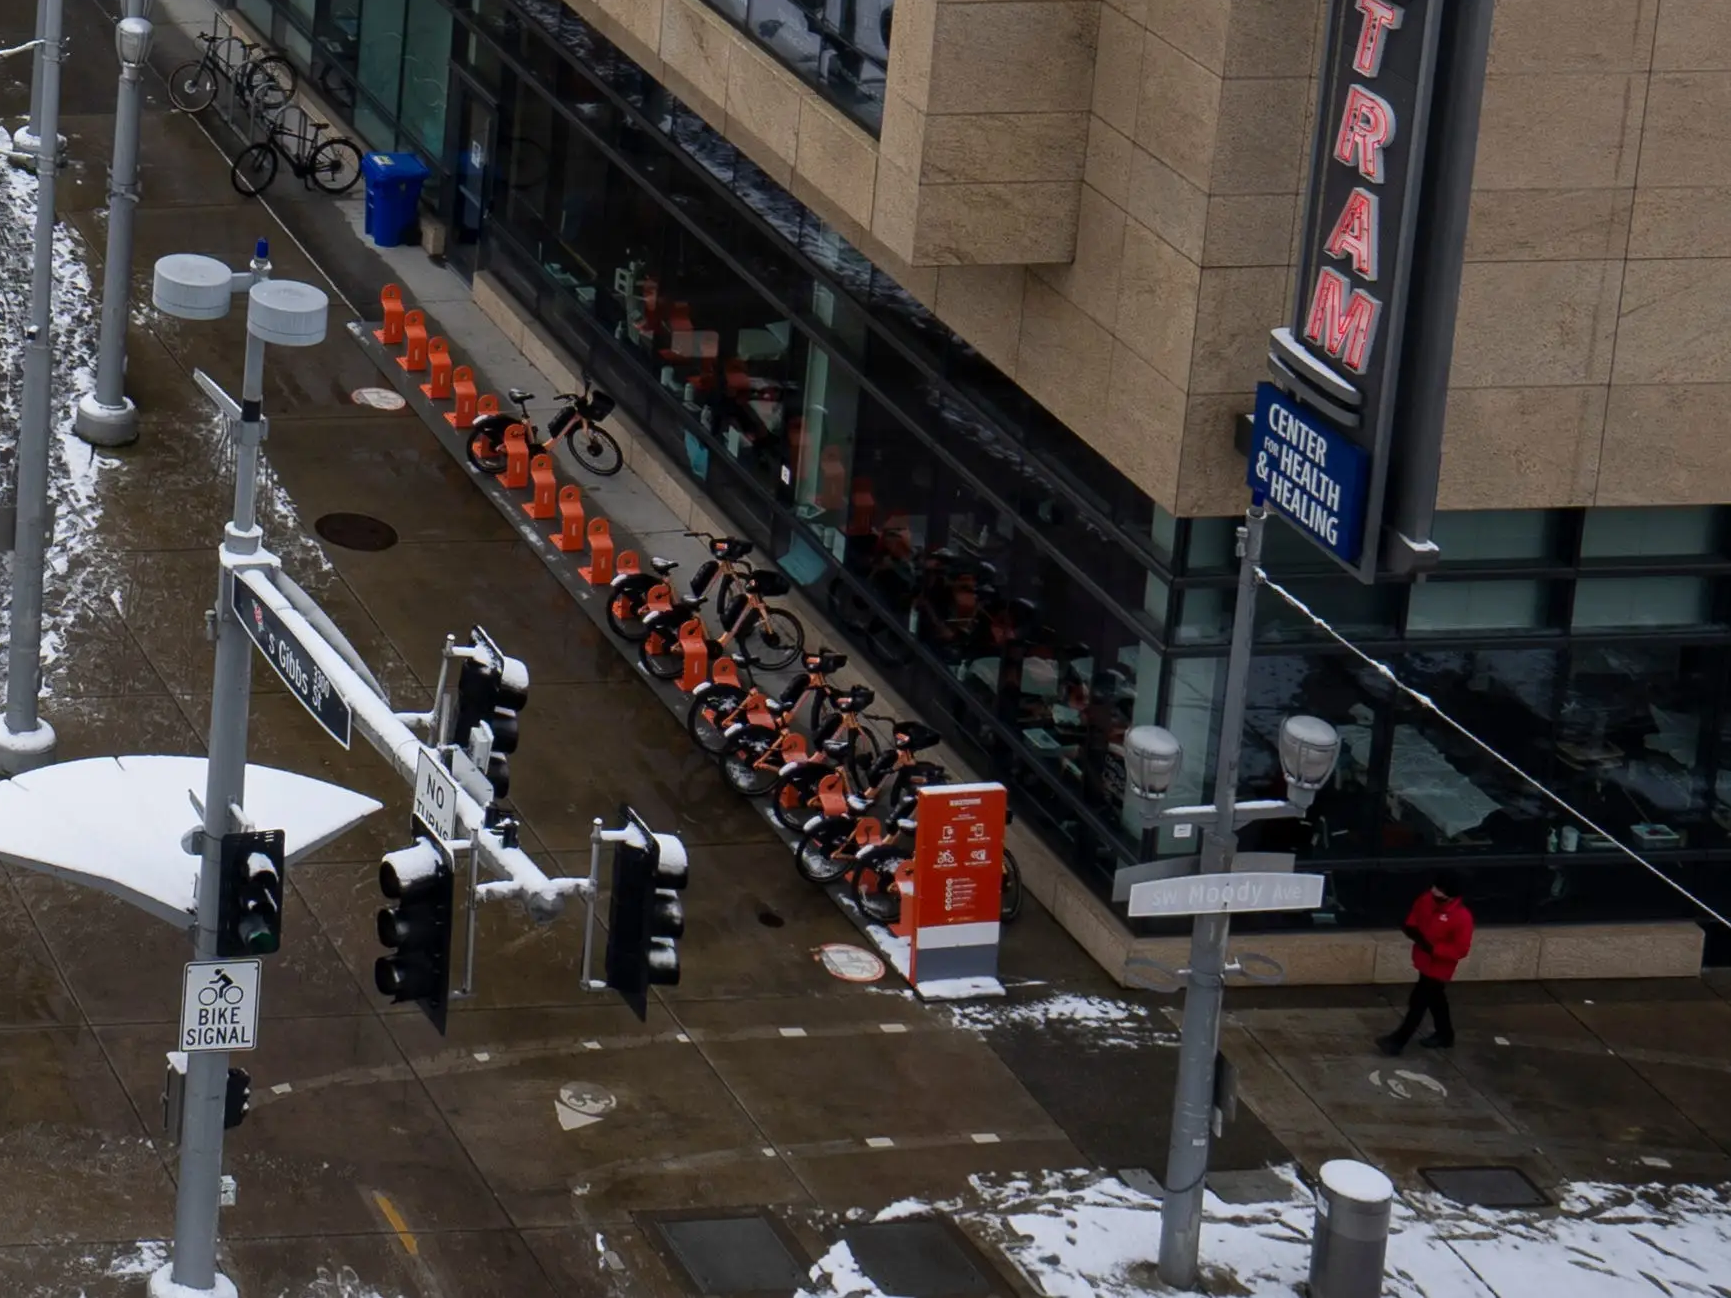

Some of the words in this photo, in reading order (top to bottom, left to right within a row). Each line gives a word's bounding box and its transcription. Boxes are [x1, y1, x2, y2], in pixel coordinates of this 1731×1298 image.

[1268, 403, 1328, 467] CENTER
[1264, 436, 1280, 457] FOR
[1280, 444, 1341, 512] HEALTH
[1256, 451, 1269, 482] &
[1270, 471, 1339, 546] HEALING
[268, 632, 275, 654] S
[278, 640, 309, 695] Gibbs
[313, 665, 330, 699] 3300
[426, 772, 445, 809] NO
[1152, 889, 1178, 906] SW
[1188, 880, 1263, 906] Moody
[1272, 884, 1303, 900] Ave
[198, 1006, 240, 1026] BIKE
[185, 1026, 251, 1046] SIGNAL
